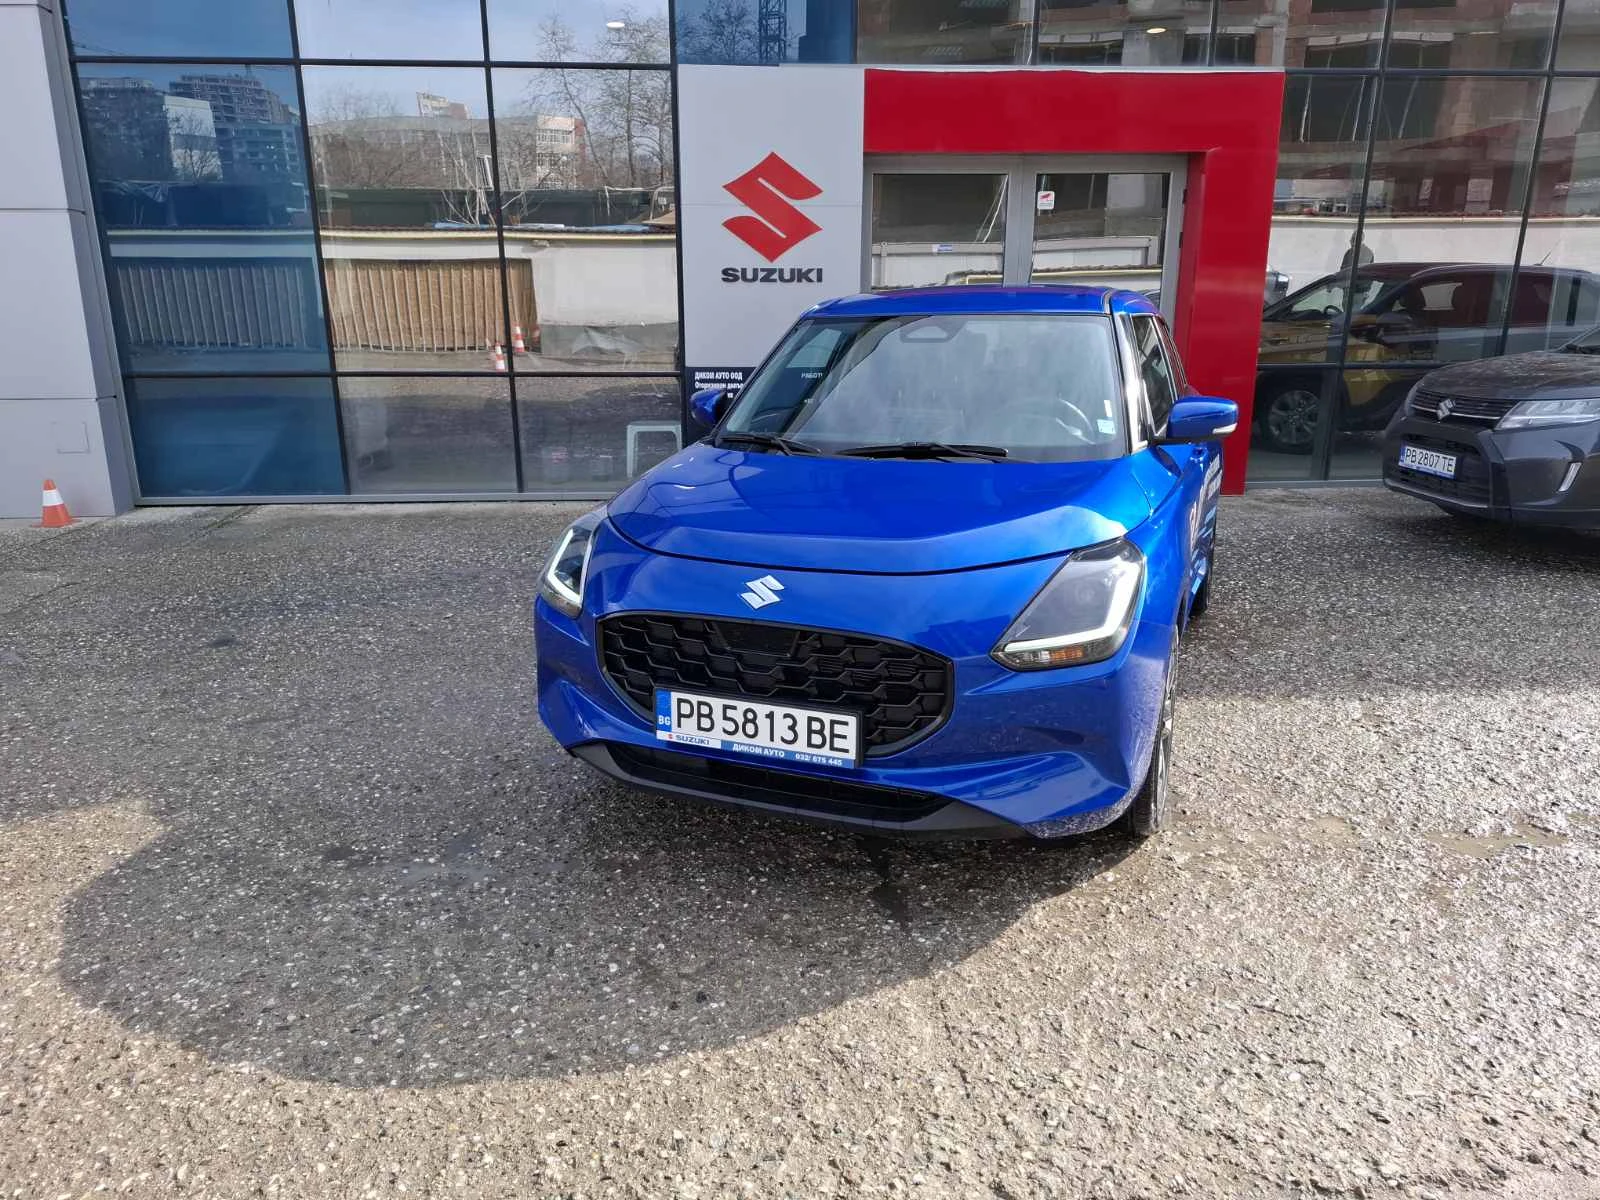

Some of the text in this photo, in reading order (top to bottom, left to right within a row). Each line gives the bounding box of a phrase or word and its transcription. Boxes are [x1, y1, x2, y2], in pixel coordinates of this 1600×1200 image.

[720, 267, 823, 283] SUZUKI
[715, 372, 730, 380] АУТО
[1406, 448, 1417, 463] PB
[1418, 451, 1440, 469] 2807
[1441, 456, 1455, 473] TE
[658, 715, 671, 726] BG
[676, 697, 850, 754] PB 5813 BE
[676, 734, 710, 745] SUZUKI
[733, 743, 785, 758] ДИКОМ АУТО
